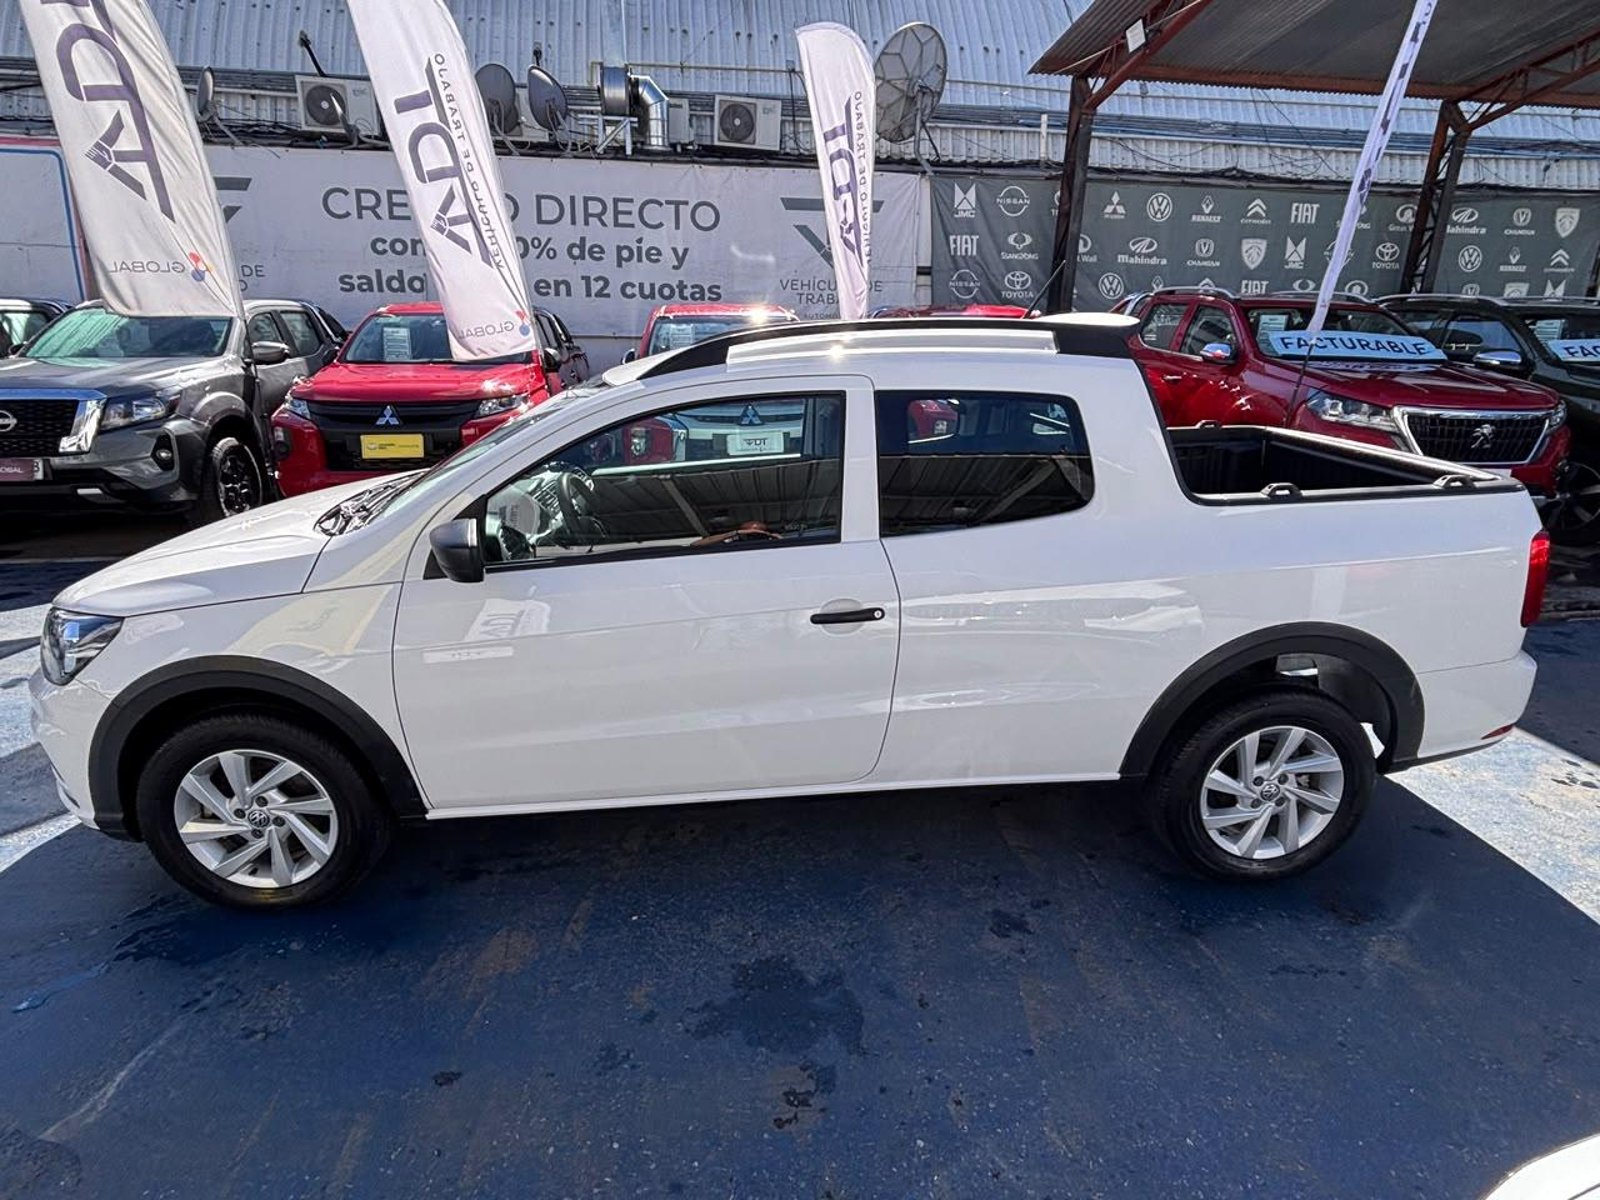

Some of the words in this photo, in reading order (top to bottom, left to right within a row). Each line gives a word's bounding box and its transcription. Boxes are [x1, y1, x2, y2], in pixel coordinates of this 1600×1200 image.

[536, 194, 721, 231] DIRECTO
[1290, 203, 1320, 224] FIAT
[370, 237, 427, 256] con
[567, 234, 605, 261] de
[671, 246, 690, 270] y
[949, 235, 979, 256] FIAT
[1117, 254, 1168, 265] Mahindra
[338, 269, 425, 294] saldo
[534, 279, 571, 298] en
[581, 275, 610, 298] 12
[620, 280, 722, 301] cuotas
[1241, 280, 1269, 296] FIAT
[1280, 336, 1428, 356] FACTURABLE
